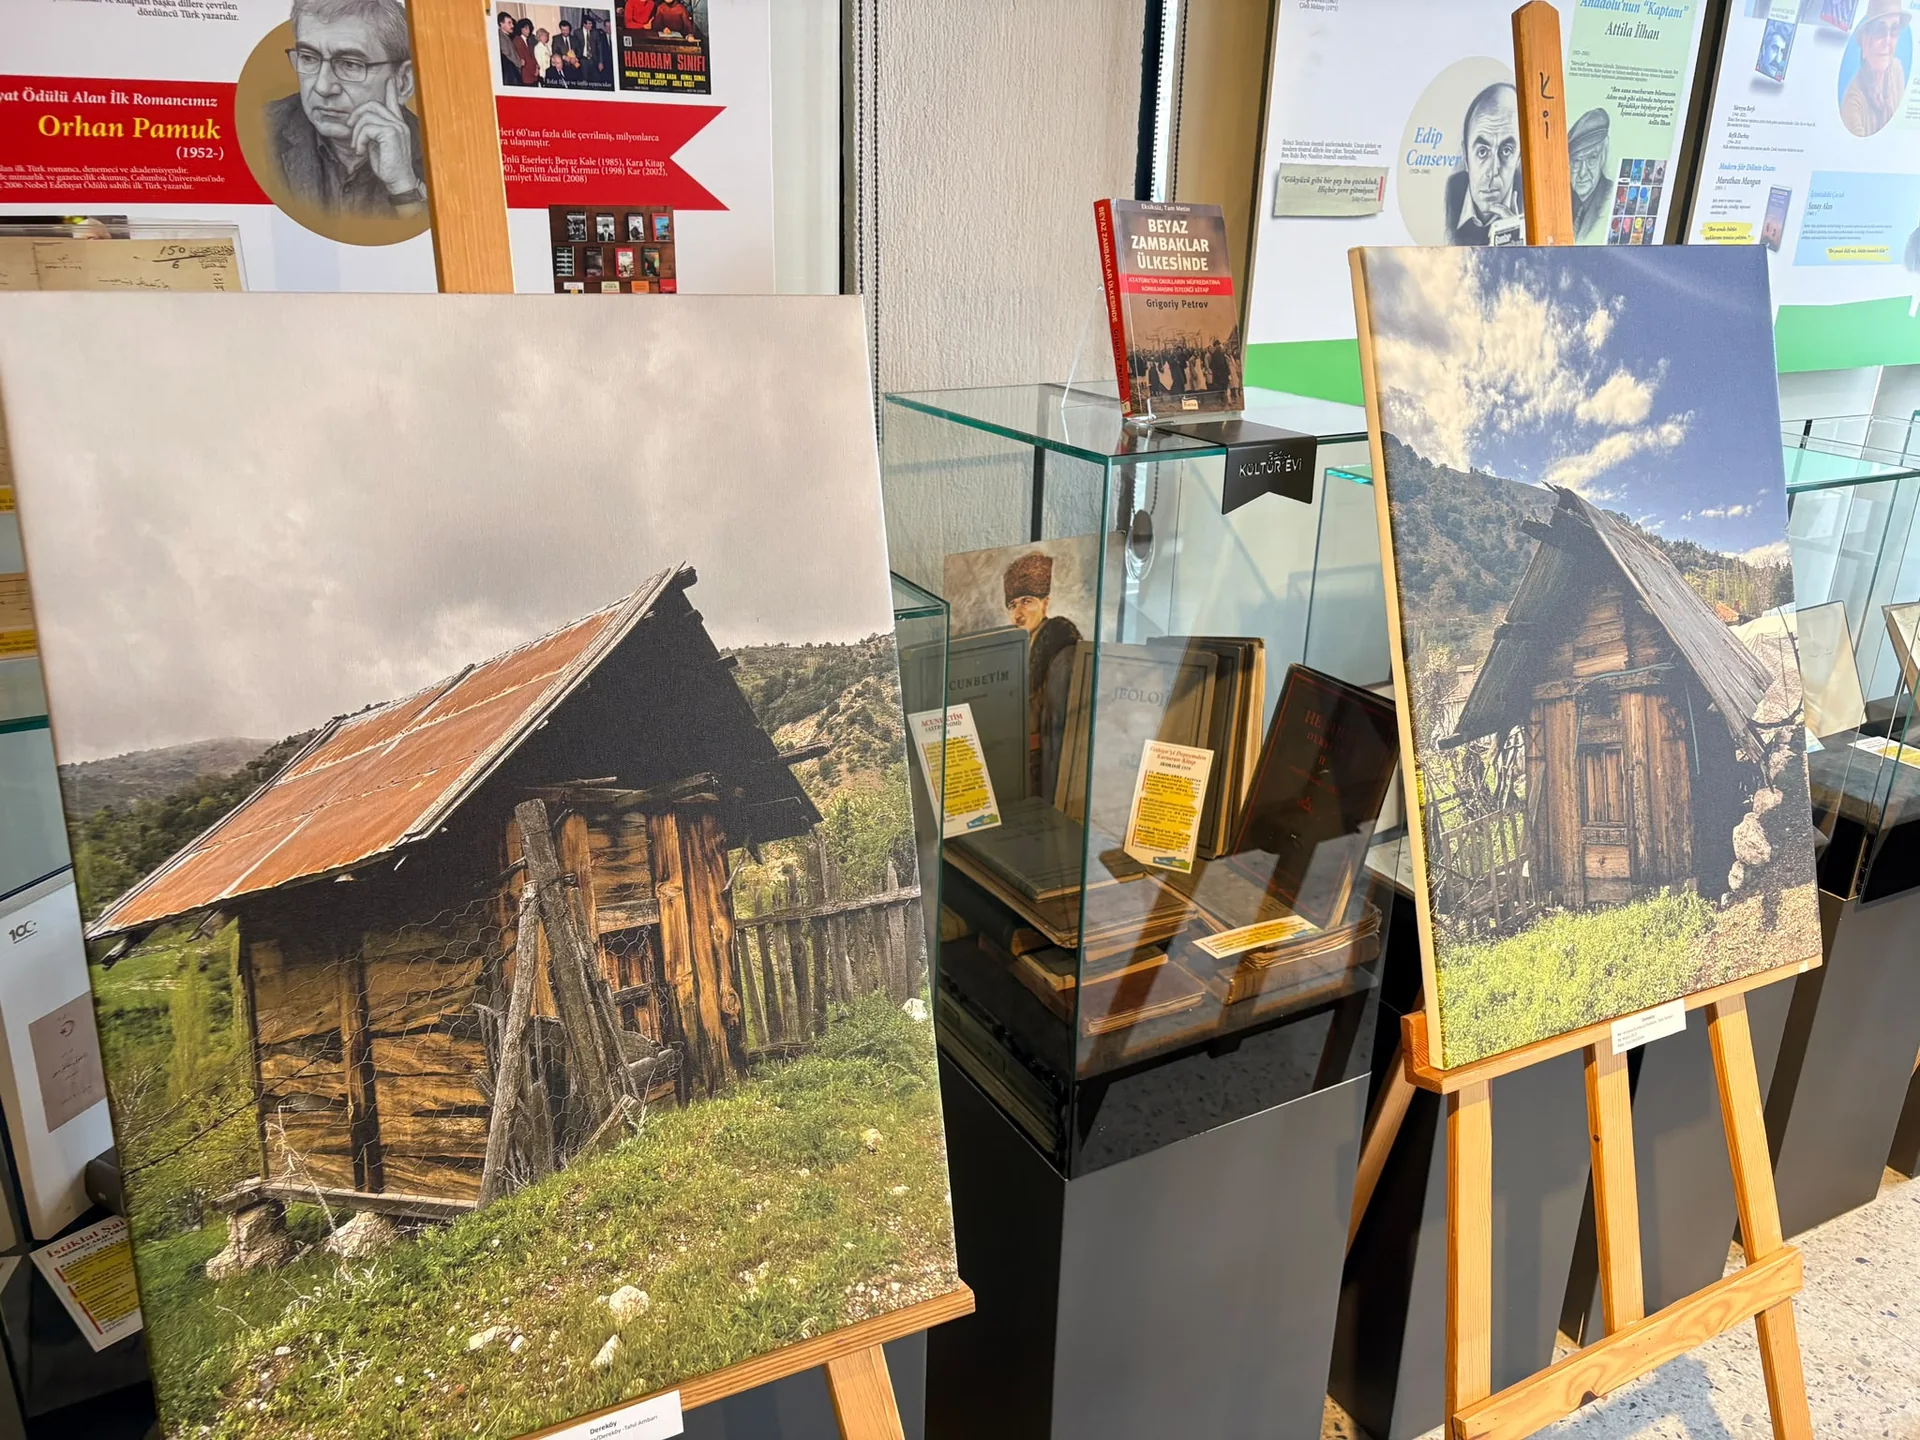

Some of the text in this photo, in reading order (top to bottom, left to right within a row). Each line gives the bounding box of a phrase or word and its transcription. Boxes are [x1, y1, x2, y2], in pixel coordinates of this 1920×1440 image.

[137, 8, 178, 17] dördüncü
[181, 10, 200, 19] Türk
[178, 1, 204, 9] dillere
[205, 3, 238, 11] çevrilen
[1605, 21, 1660, 40] Attila İlhan
[624, 50, 706, 72] HABABAM SINIFI
[22, 87, 69, 103] Ödülü
[72, 91, 106, 104] Alan
[110, 89, 130, 105] İlk
[133, 93, 218, 108] Romancımız
[38, 114, 221, 140] Orhan Pamuk
[516, 128, 540, 138] 60'tan
[541, 129, 560, 139] fazla
[561, 130, 576, 139] dile
[577, 131, 615, 142] çevrilmiş,
[616, 131, 659, 143] milyonlarca
[1414, 126, 1443, 149] Edip
[176, 146, 224, 160] (1952-)
[1406, 149, 1462, 168] Cansever
[555, 157, 577, 167] Beyaz
[579, 157, 596, 166] Kale
[625, 158, 643, 167] Kara
[645, 159, 665, 169] Kitap
[520, 166, 546, 174] Benim
[547, 166, 569, 174] Adım
[571, 166, 600, 175] Kırmızı
[601, 167, 625, 176] (1998)
[534, 174, 561, 183] Müzesi
[562, 174, 588, 183] (2008)
[24, 181, 48, 189] Nobel
[143, 182, 161, 190] Türk
[1148, 218, 1188, 234] BEYAZ
[159, 245, 187, 256] 150
[1131, 235, 1210, 253] ZAMBAKLAR
[171, 259, 180, 270] 6
[1137, 251, 1209, 271] ÜLKESİNDE
[1146, 299, 1208, 310] Grigoriy Petrov
[1239, 460, 1281, 477] KÜLTÜR
[946, 669, 1010, 692] CUNBETİM
[590, 1421, 618, 1435] Dereköy
